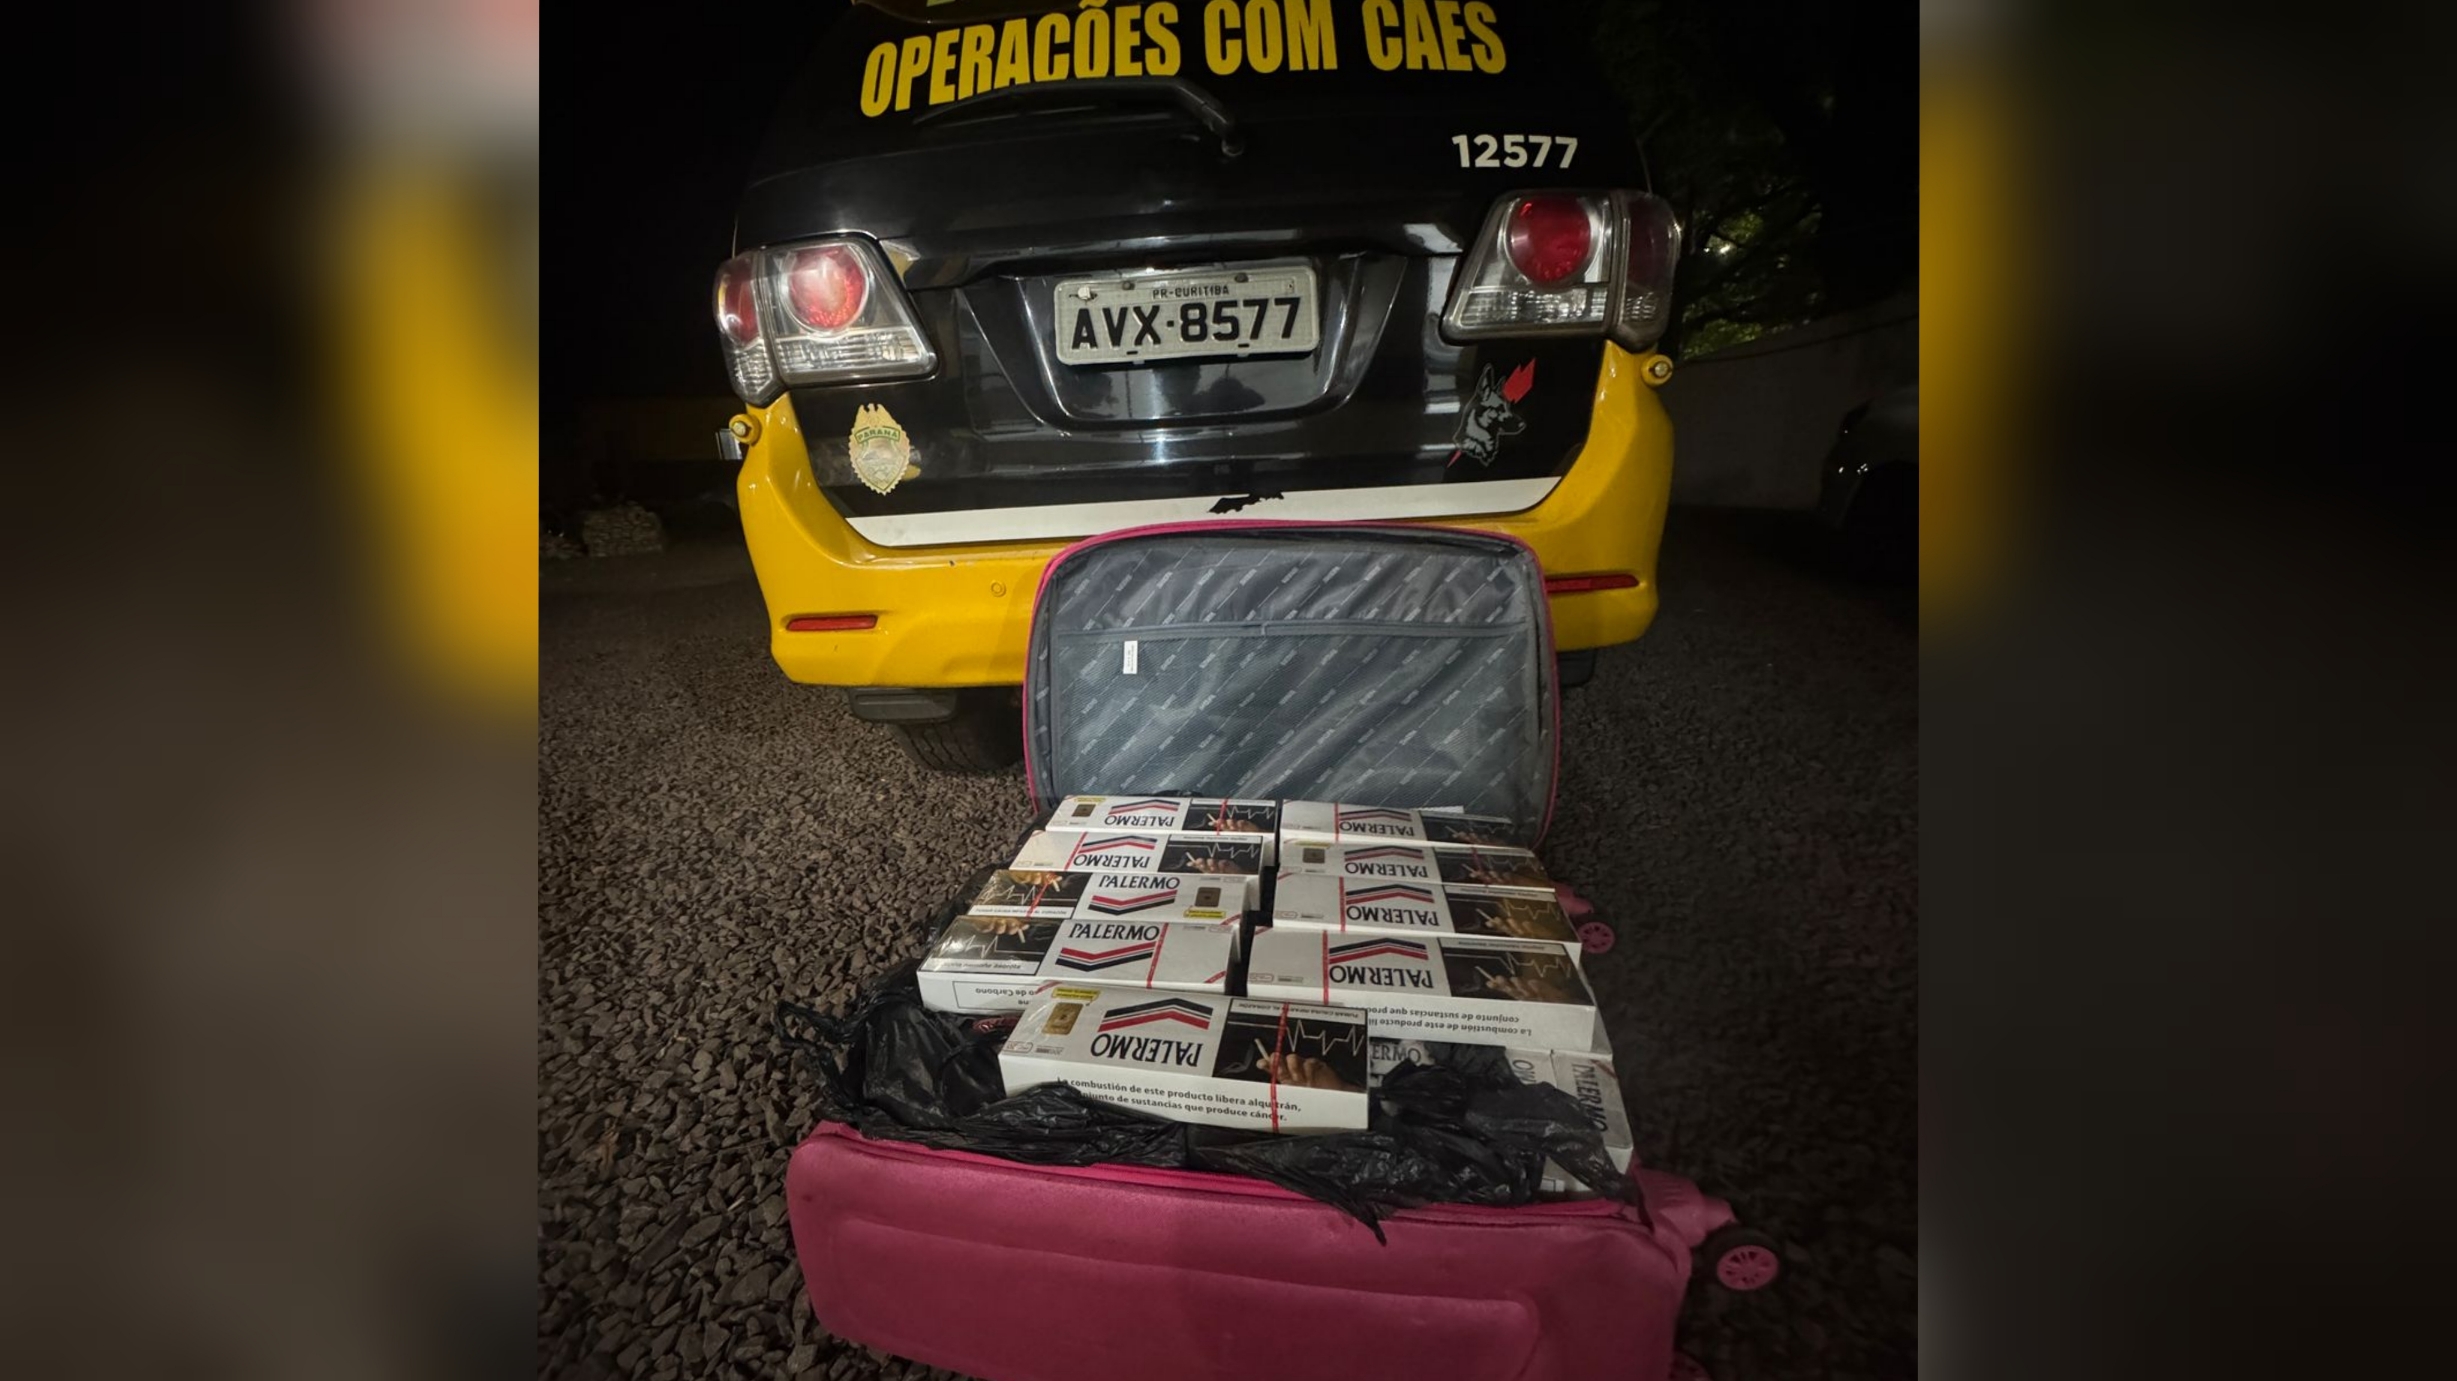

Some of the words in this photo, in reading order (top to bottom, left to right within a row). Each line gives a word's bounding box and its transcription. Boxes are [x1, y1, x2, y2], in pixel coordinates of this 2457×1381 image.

[1203, 0, 1338, 76] COM
[1451, 134, 1578, 169] 12577
[1152, 285, 1230, 300] PR-CURITIBA
[1104, 815, 1175, 827] PALERMO
[1339, 821, 1415, 837] PALERMO
[1073, 853, 1151, 868] PALERMO
[1344, 862, 1429, 878] PALERMO
[1098, 875, 1181, 889] PALERMO
[1346, 905, 1440, 927] PALERMO
[1068, 923, 1160, 941] PALERMO
[1329, 965, 1434, 989] PALERMO
[975, 988, 1014, 997] Carbono
[1389, 1006, 1408, 1015] que
[1410, 1008, 1459, 1019] sustancias
[1462, 1012, 1474, 1021] de
[1380, 1017, 1423, 1027] producto
[1425, 1020, 1445, 1029] este
[1475, 1013, 1519, 1024] conjunto
[1446, 1022, 1459, 1031] de
[1461, 1023, 1518, 1035] combustión
[1520, 1028, 1532, 1037] La
[1089, 1033, 1204, 1067] PALERMO
[1371, 1043, 1421, 1065] ERMO
[1070, 1079, 1128, 1092] combustión
[1129, 1084, 1142, 1094] de
[1144, 1086, 1165, 1096] este
[1167, 1090, 1213, 1103] producto
[1214, 1094, 1246, 1106] libera
[1248, 1097, 1302, 1112] alqutrán,
[1116, 1094, 1129, 1103] de
[1131, 1097, 1183, 1110] sustancias
[1184, 1103, 1205, 1113] que
[1206, 1105, 1248, 1118] produce
